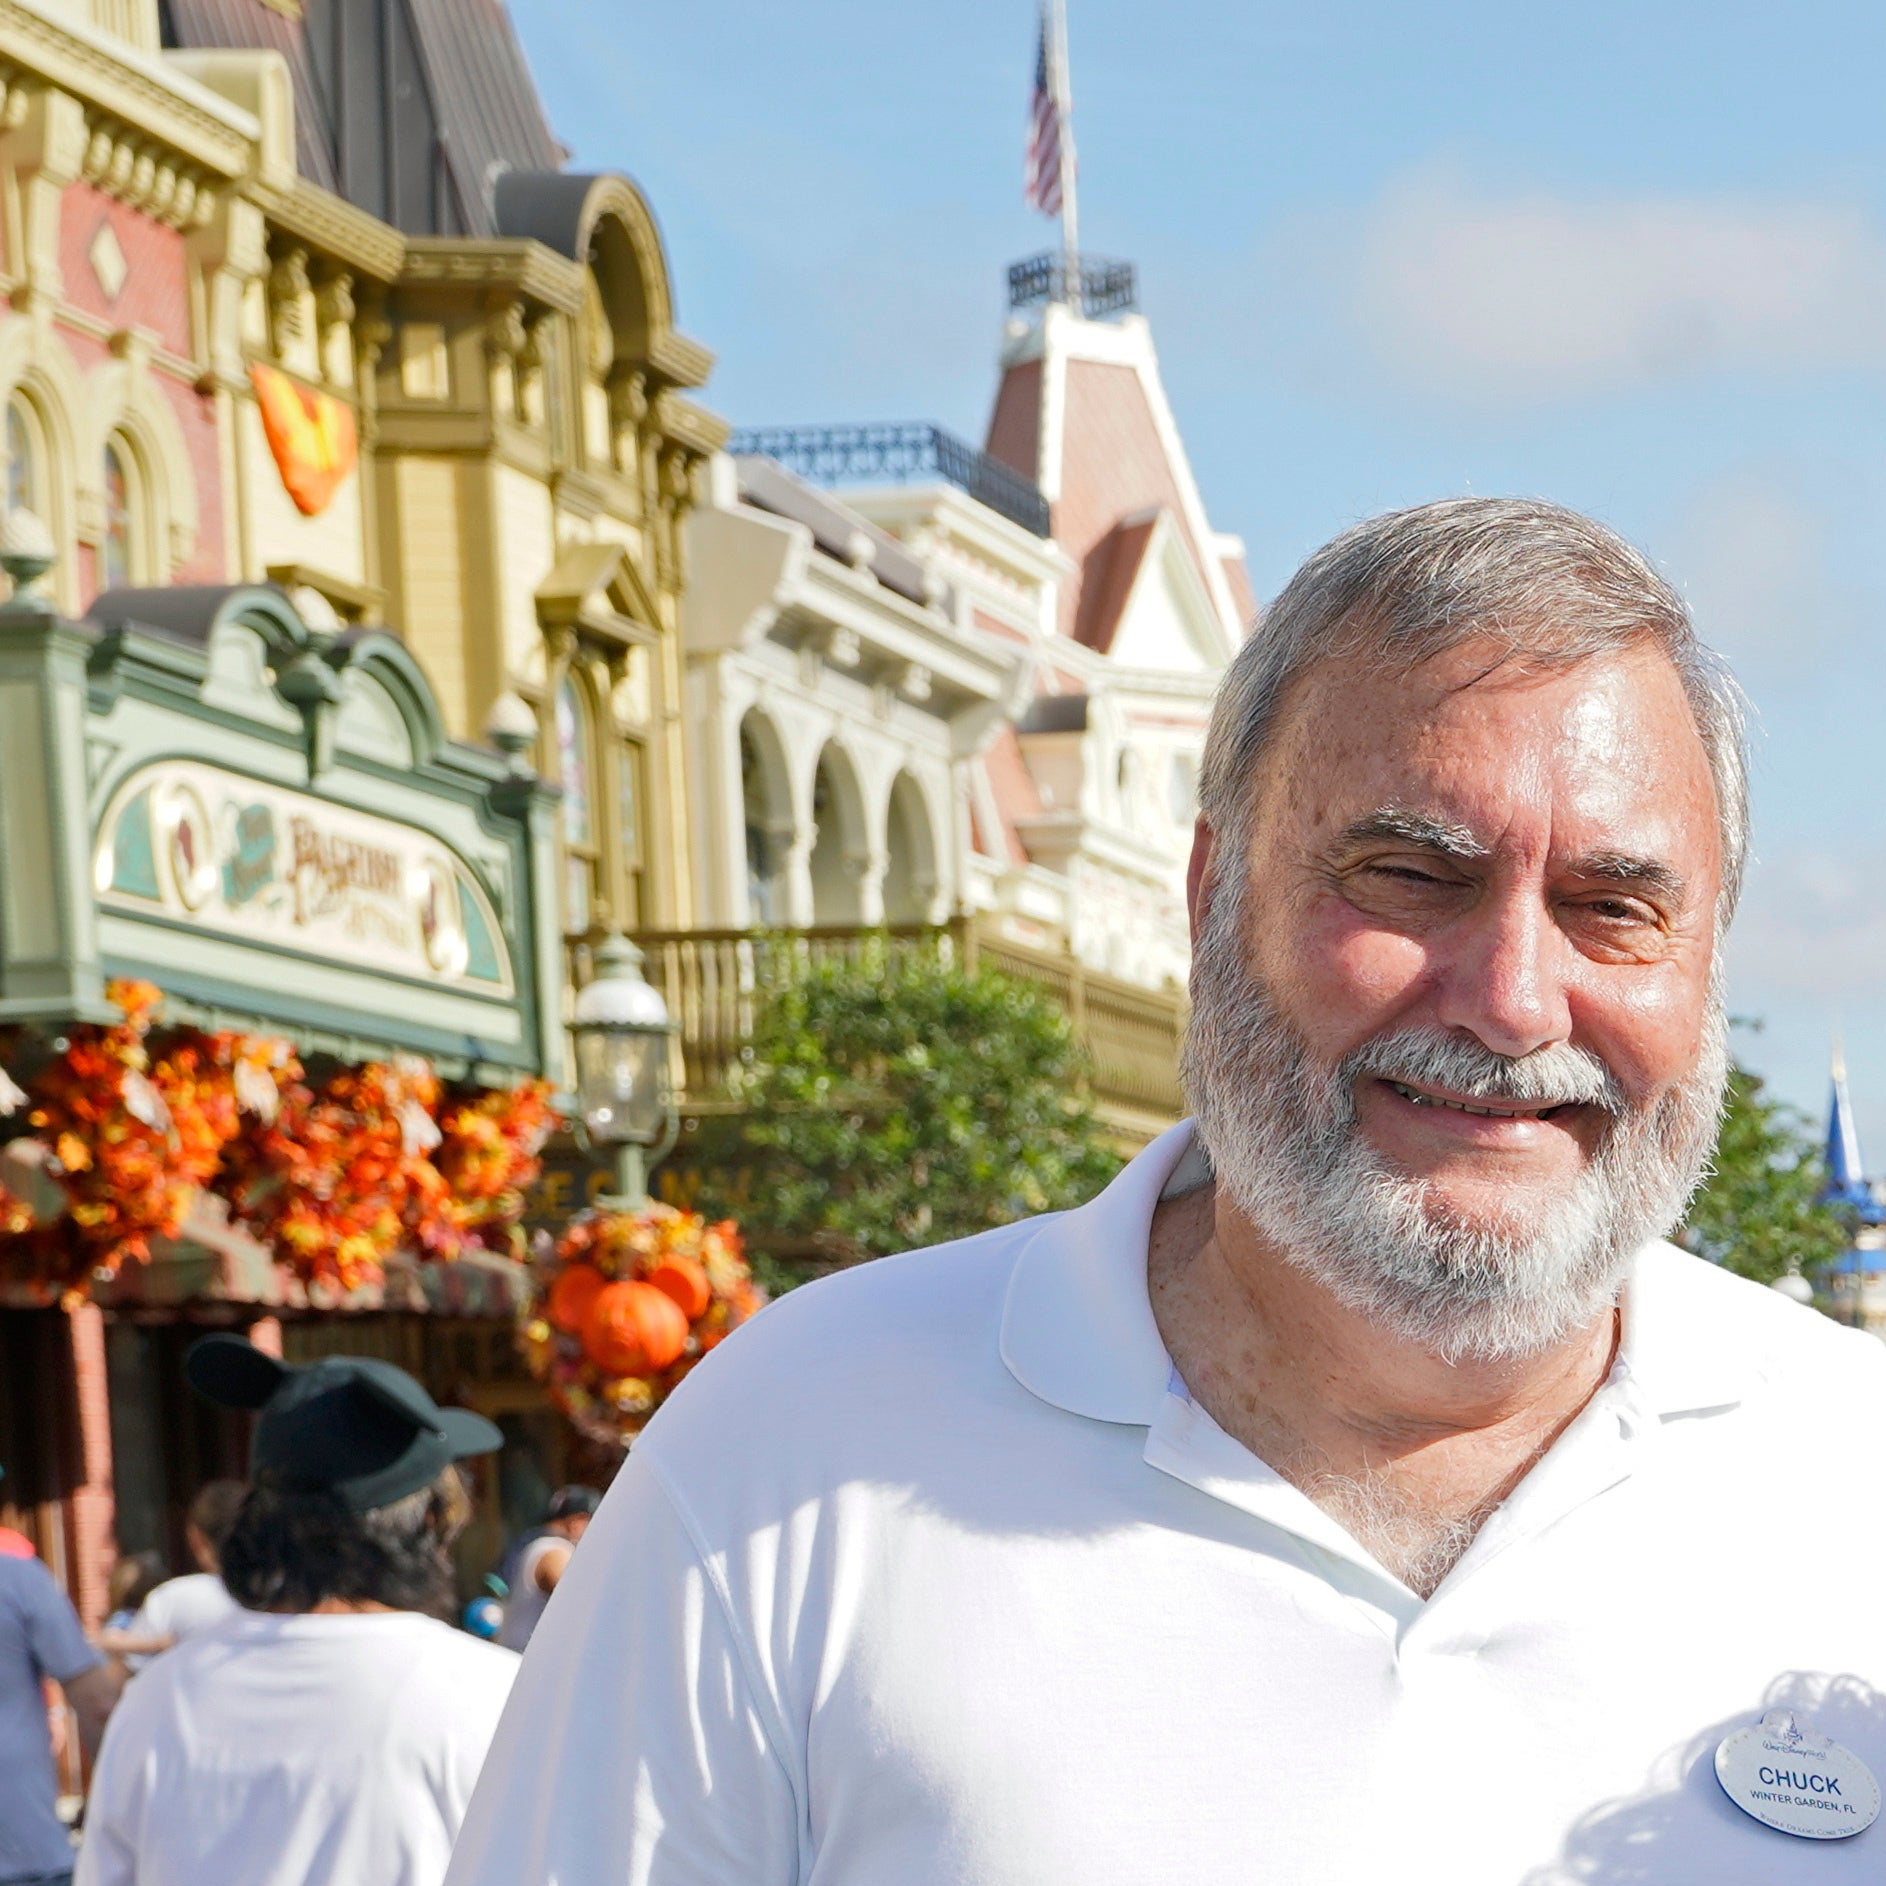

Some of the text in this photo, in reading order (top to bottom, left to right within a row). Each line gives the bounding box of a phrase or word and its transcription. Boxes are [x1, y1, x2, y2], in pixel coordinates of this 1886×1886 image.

[1758, 1766, 1842, 1796] CHUCK
[1750, 1789, 1857, 1814] WINTER GARDEN, FL
